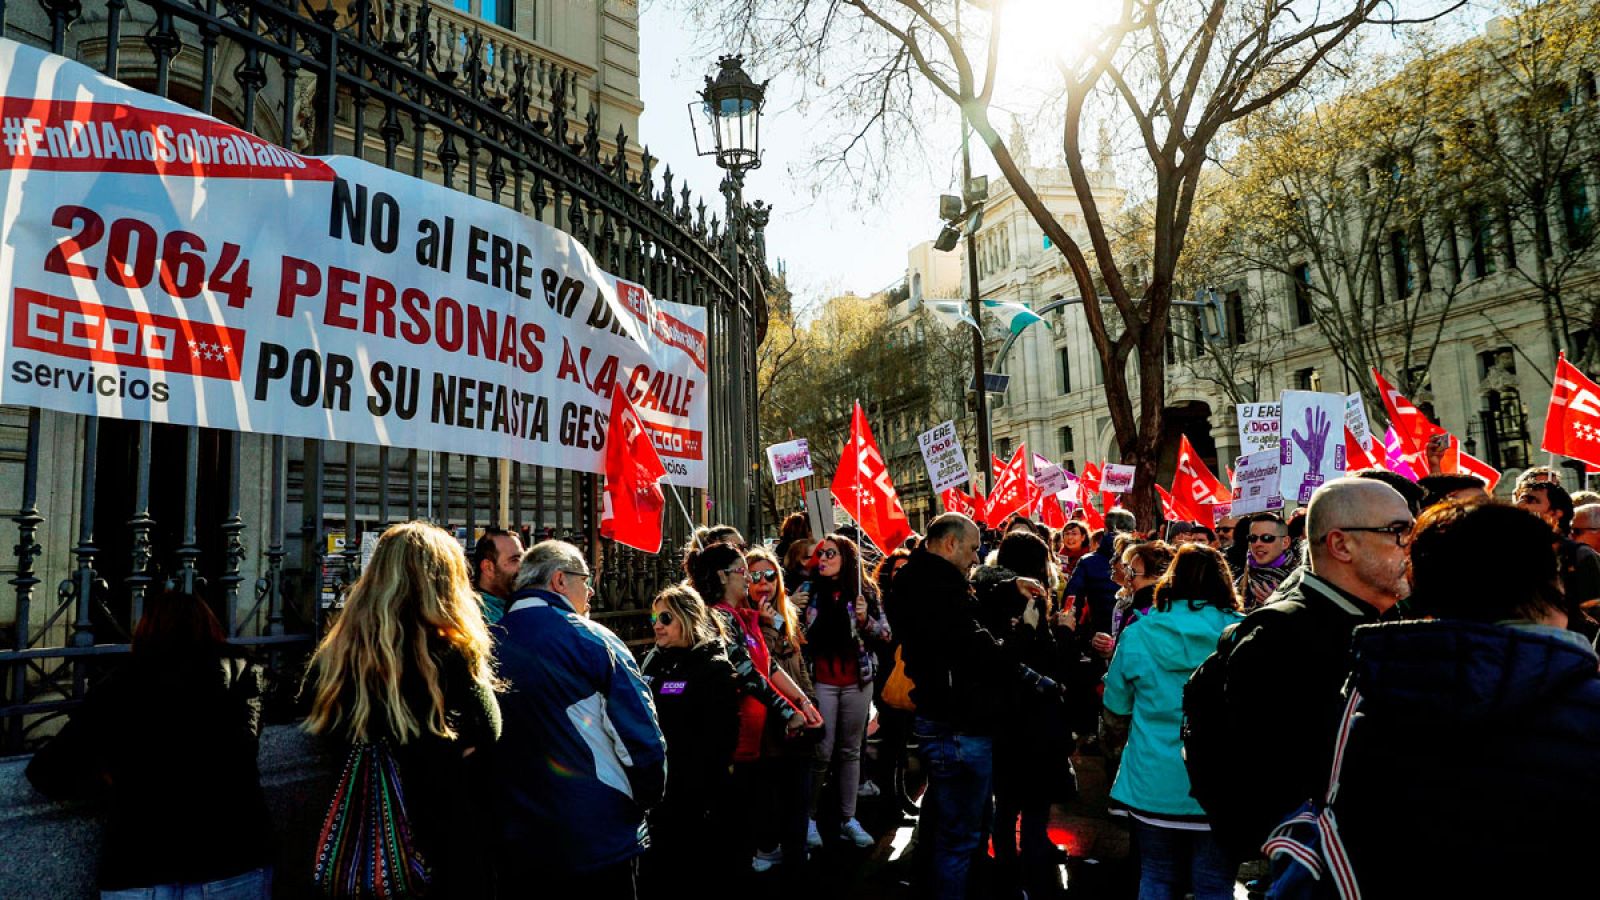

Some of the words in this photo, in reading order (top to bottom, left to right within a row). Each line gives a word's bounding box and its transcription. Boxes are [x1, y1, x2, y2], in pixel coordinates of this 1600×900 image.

[328, 177, 400, 254] NO
[415, 215, 455, 273] al
[465, 224, 533, 300] ERE
[540, 266, 585, 318] en
[27, 301, 177, 361] CCOO
[44, 204, 253, 310] 2064
[276, 255, 546, 374] PERSONAS
[556, 336, 582, 385] A
[579, 346, 620, 400] LA
[626, 363, 697, 417] CALLE
[11, 358, 170, 402] servicios
[254, 341, 354, 413] POR
[367, 360, 421, 422] SU
[430, 371, 550, 443] NEFASTA
[558, 401, 610, 452] GES
[652, 430, 684, 453] COO
